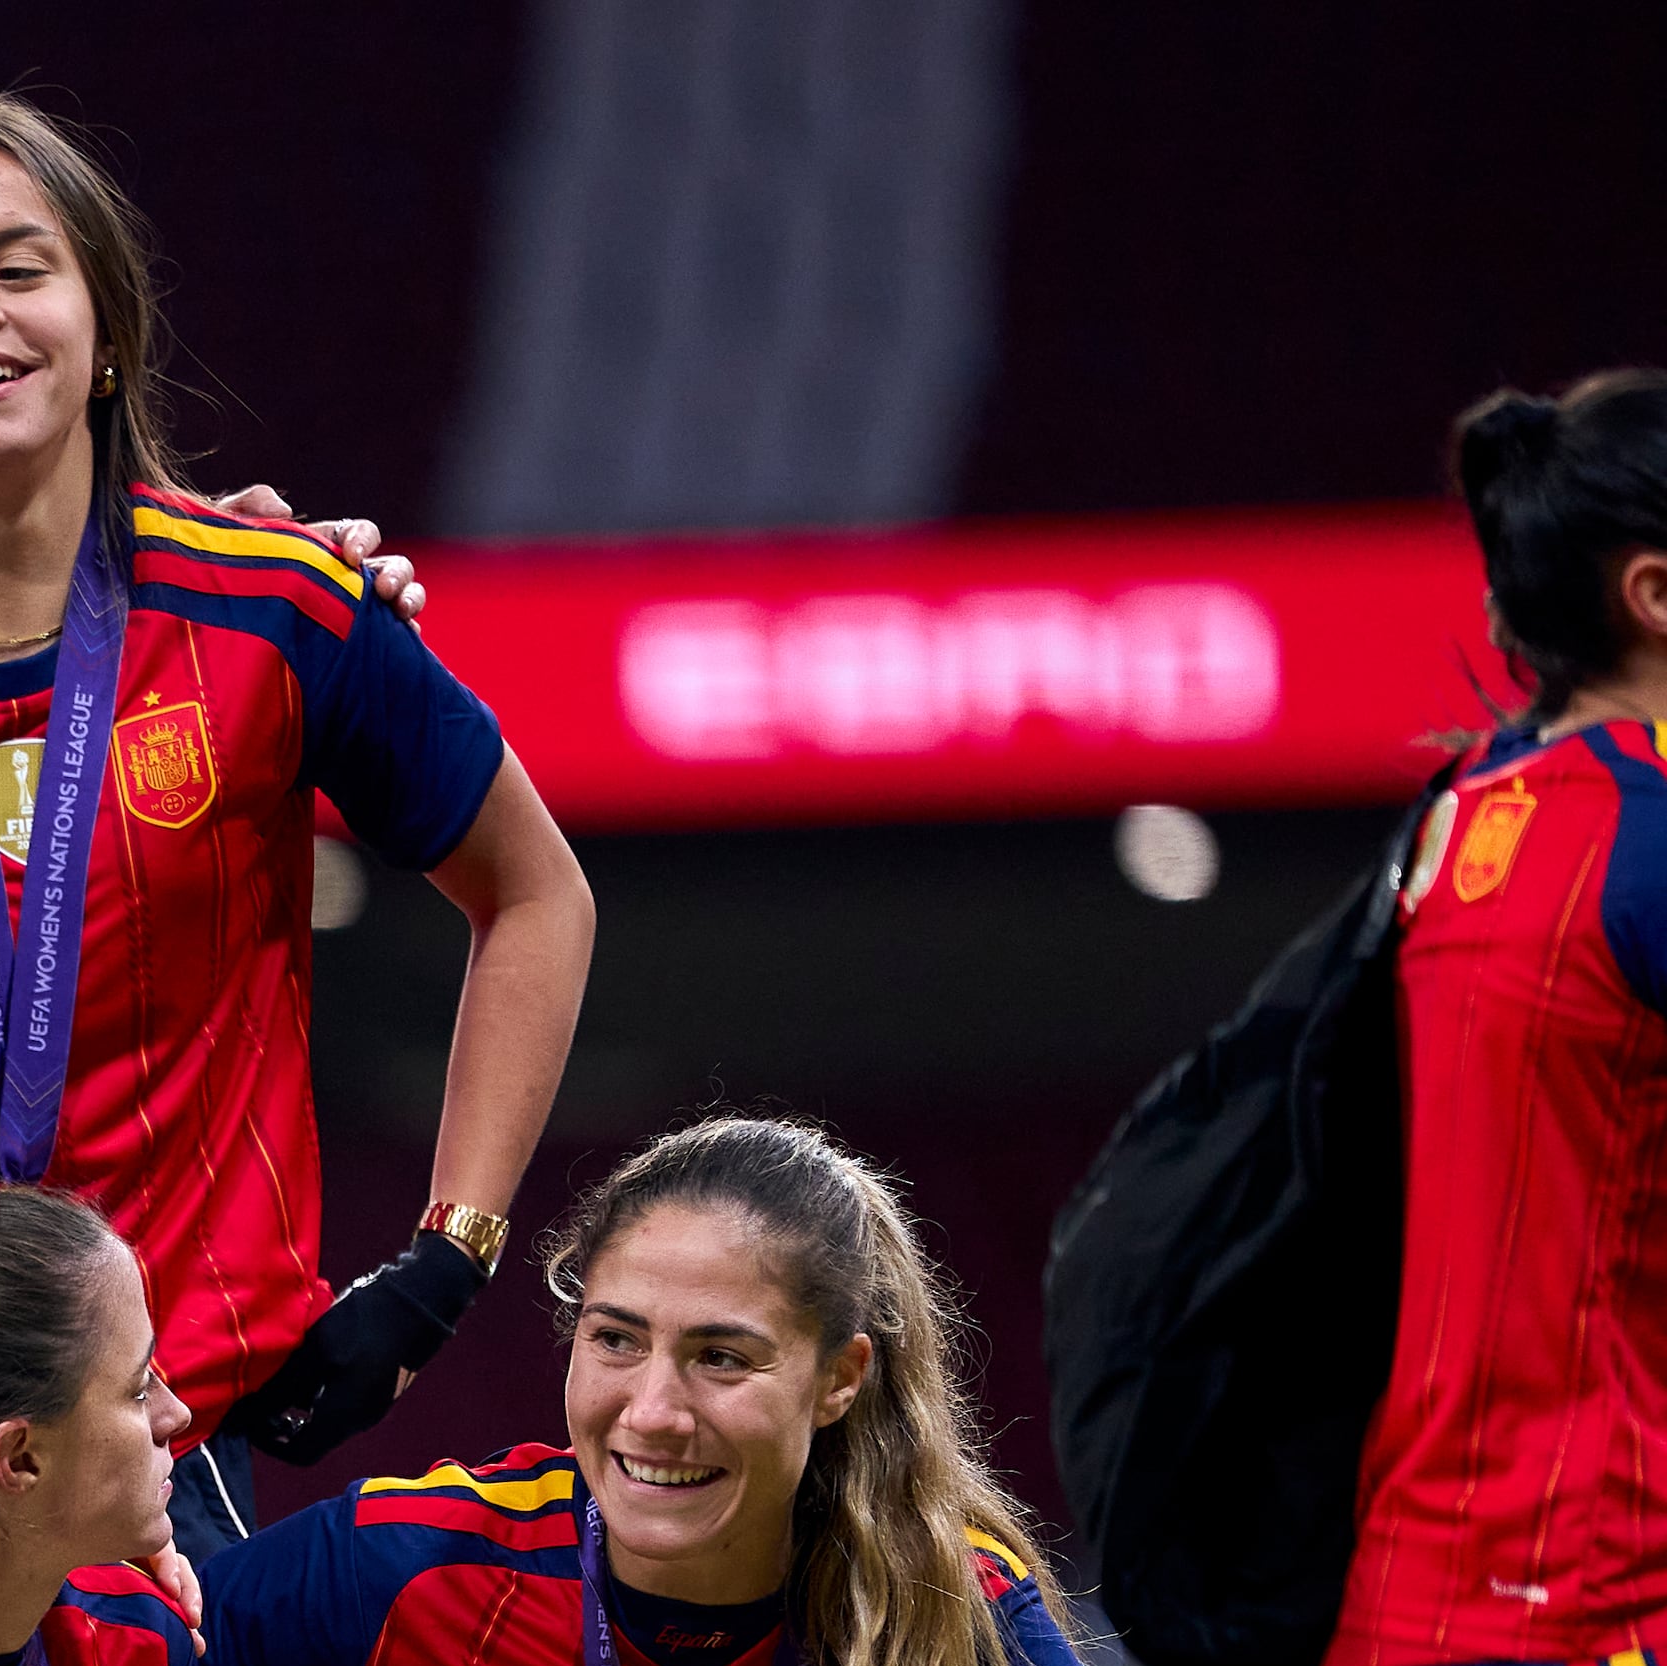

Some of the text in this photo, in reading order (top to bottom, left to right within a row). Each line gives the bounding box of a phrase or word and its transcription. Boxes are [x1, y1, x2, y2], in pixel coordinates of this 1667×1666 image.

[7, 817, 34, 835] FIF
[27, 690, 94, 1053] UEFA WOMEN'S NATIONS LEAGUE
